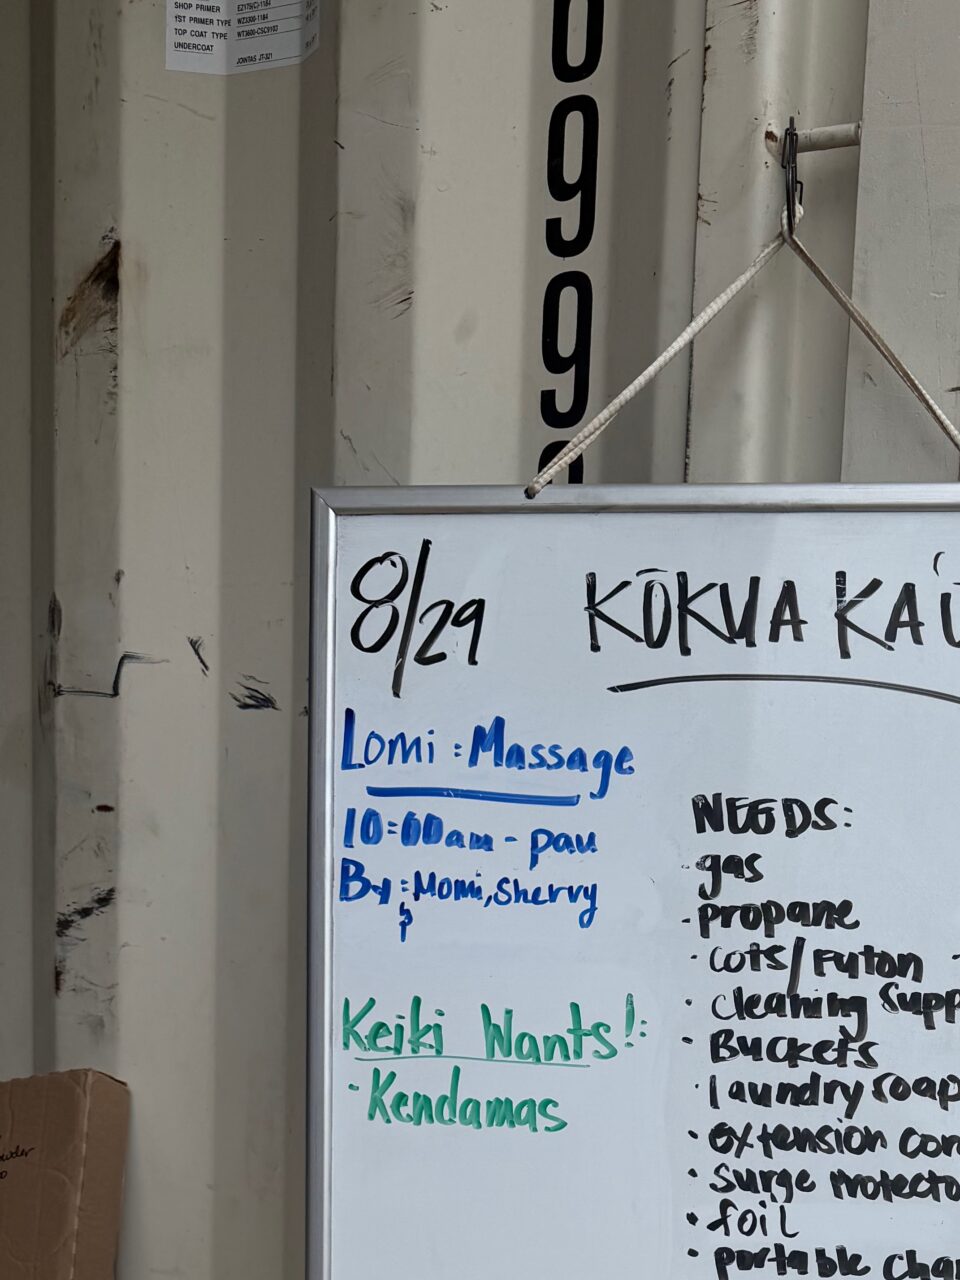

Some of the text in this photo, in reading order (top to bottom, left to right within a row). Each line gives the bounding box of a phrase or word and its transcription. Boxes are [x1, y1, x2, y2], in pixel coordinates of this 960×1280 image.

[174, 2, 221, 13] SHOP PRIMER
[174, 15, 232, 27] 1ST PRIMER TYPE
[173, 41, 214, 52] UNDERCOAT
[174, 28, 228, 40] TOP COAT TYPE
[350, 538, 486, 699] 8/29
[691, 792, 853, 838] NEEDS:
[695, 852, 764, 900] gas
[698, 899, 861, 939] propane
[342, 995, 446, 1056] Keiki
[709, 1025, 879, 1069] Buckets
[367, 1065, 568, 1133] Kendamas
